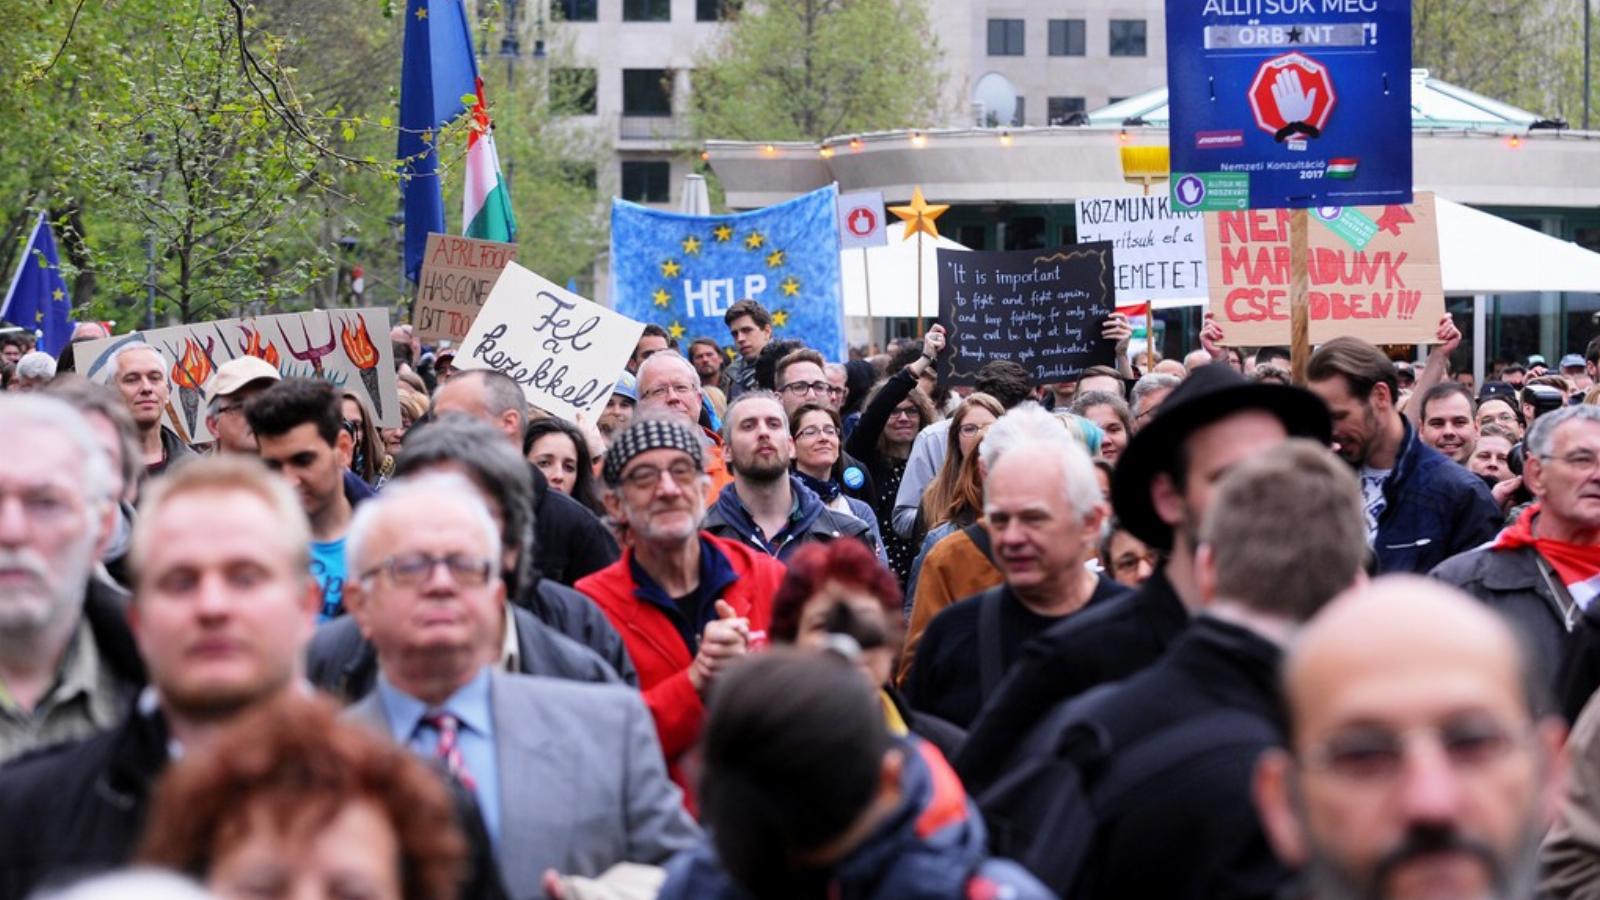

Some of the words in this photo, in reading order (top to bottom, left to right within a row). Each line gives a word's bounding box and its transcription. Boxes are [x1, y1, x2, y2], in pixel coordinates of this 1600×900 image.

[1322, 0, 1377, 12] MEG
[1220, 161, 1264, 172] Nemzeti
[1266, 159, 1325, 170] Konzultáció
[1300, 170, 1324, 180] 2017
[1162, 225, 1180, 244] el
[1183, 233, 1195, 243] a
[975, 269, 987, 285] is
[995, 262, 1060, 292] important
[422, 271, 456, 302] HAS
[454, 275, 491, 306] GONE
[684, 274, 767, 318] HELP
[955, 290, 967, 306] to
[1002, 293, 1024, 305] and
[1031, 291, 1052, 307] fight
[418, 306, 445, 333] BIT
[447, 311, 471, 337] TOO
[533, 291, 600, 351] Fel
[958, 313, 977, 323] and
[1065, 304, 1086, 320] only
[960, 332, 978, 341] can
[982, 329, 1002, 340] evil
[1008, 328, 1021, 341] be
[1025, 326, 1042, 343] kept
[1047, 324, 1059, 336] at
[1065, 322, 1082, 341] bay
[542, 338, 563, 354] a
[988, 351, 1013, 360] never
[473, 324, 614, 411] kezekkel!
